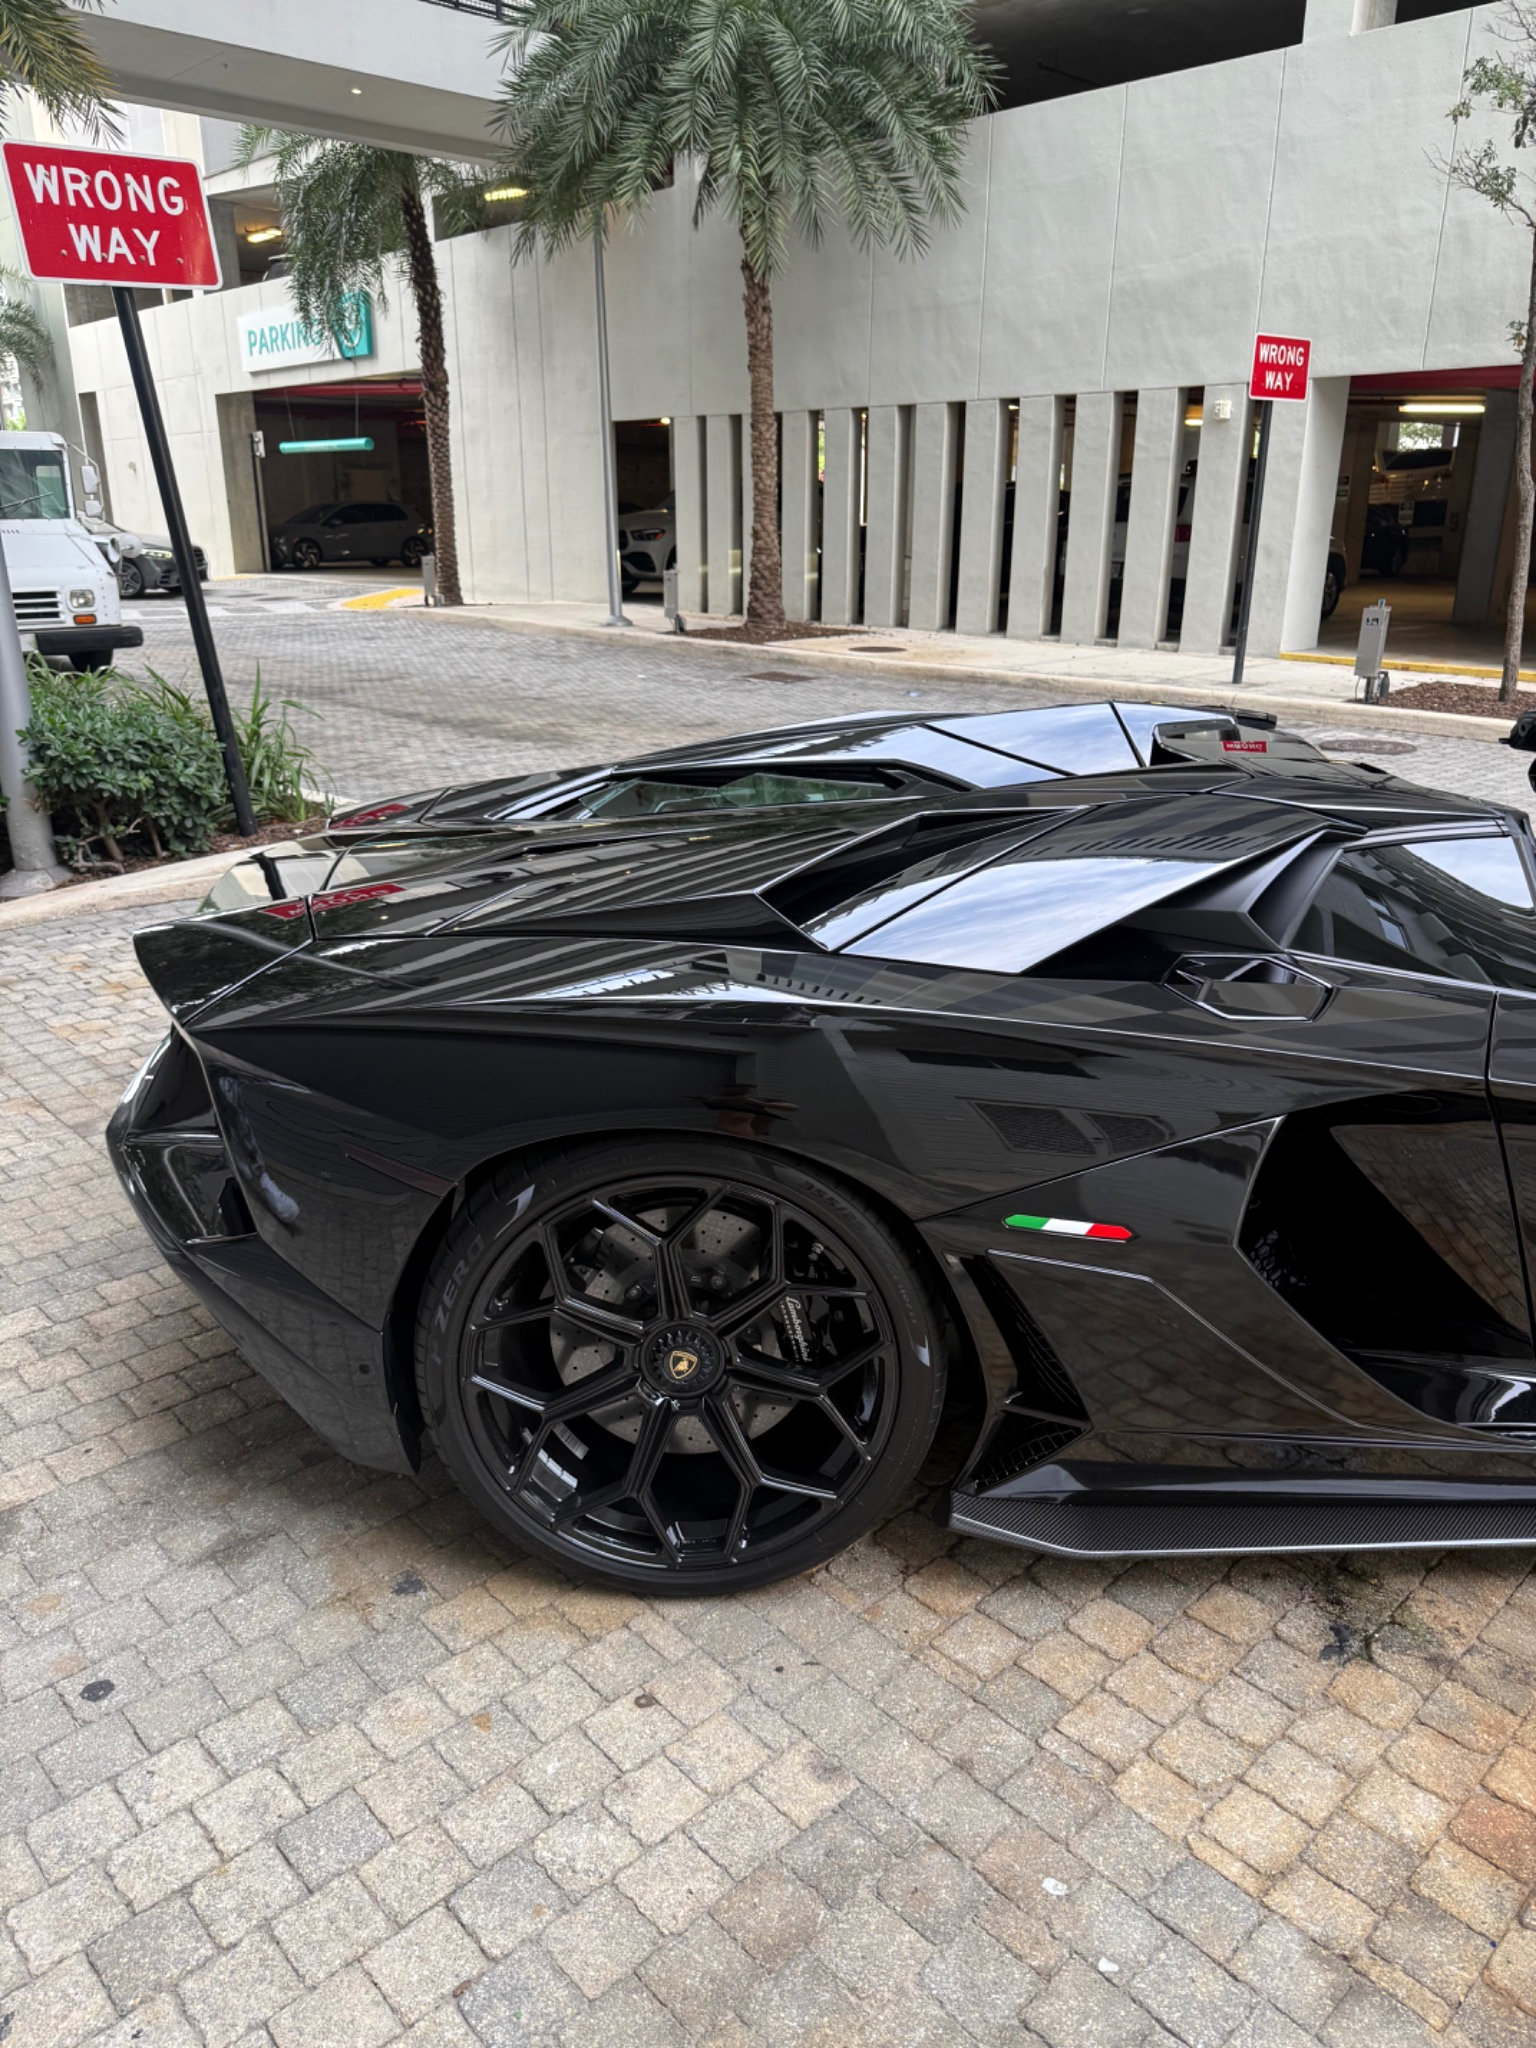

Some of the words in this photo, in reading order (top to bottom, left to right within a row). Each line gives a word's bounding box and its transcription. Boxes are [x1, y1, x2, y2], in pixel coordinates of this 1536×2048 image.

[23, 162, 185, 216] WRONG
[68, 223, 160, 266] WAY
[247, 318, 323, 357] PARKING
[1260, 343, 1304, 366] WRONG
[1265, 371, 1294, 391] WAY
[434, 1234, 485, 1335] ZERO
